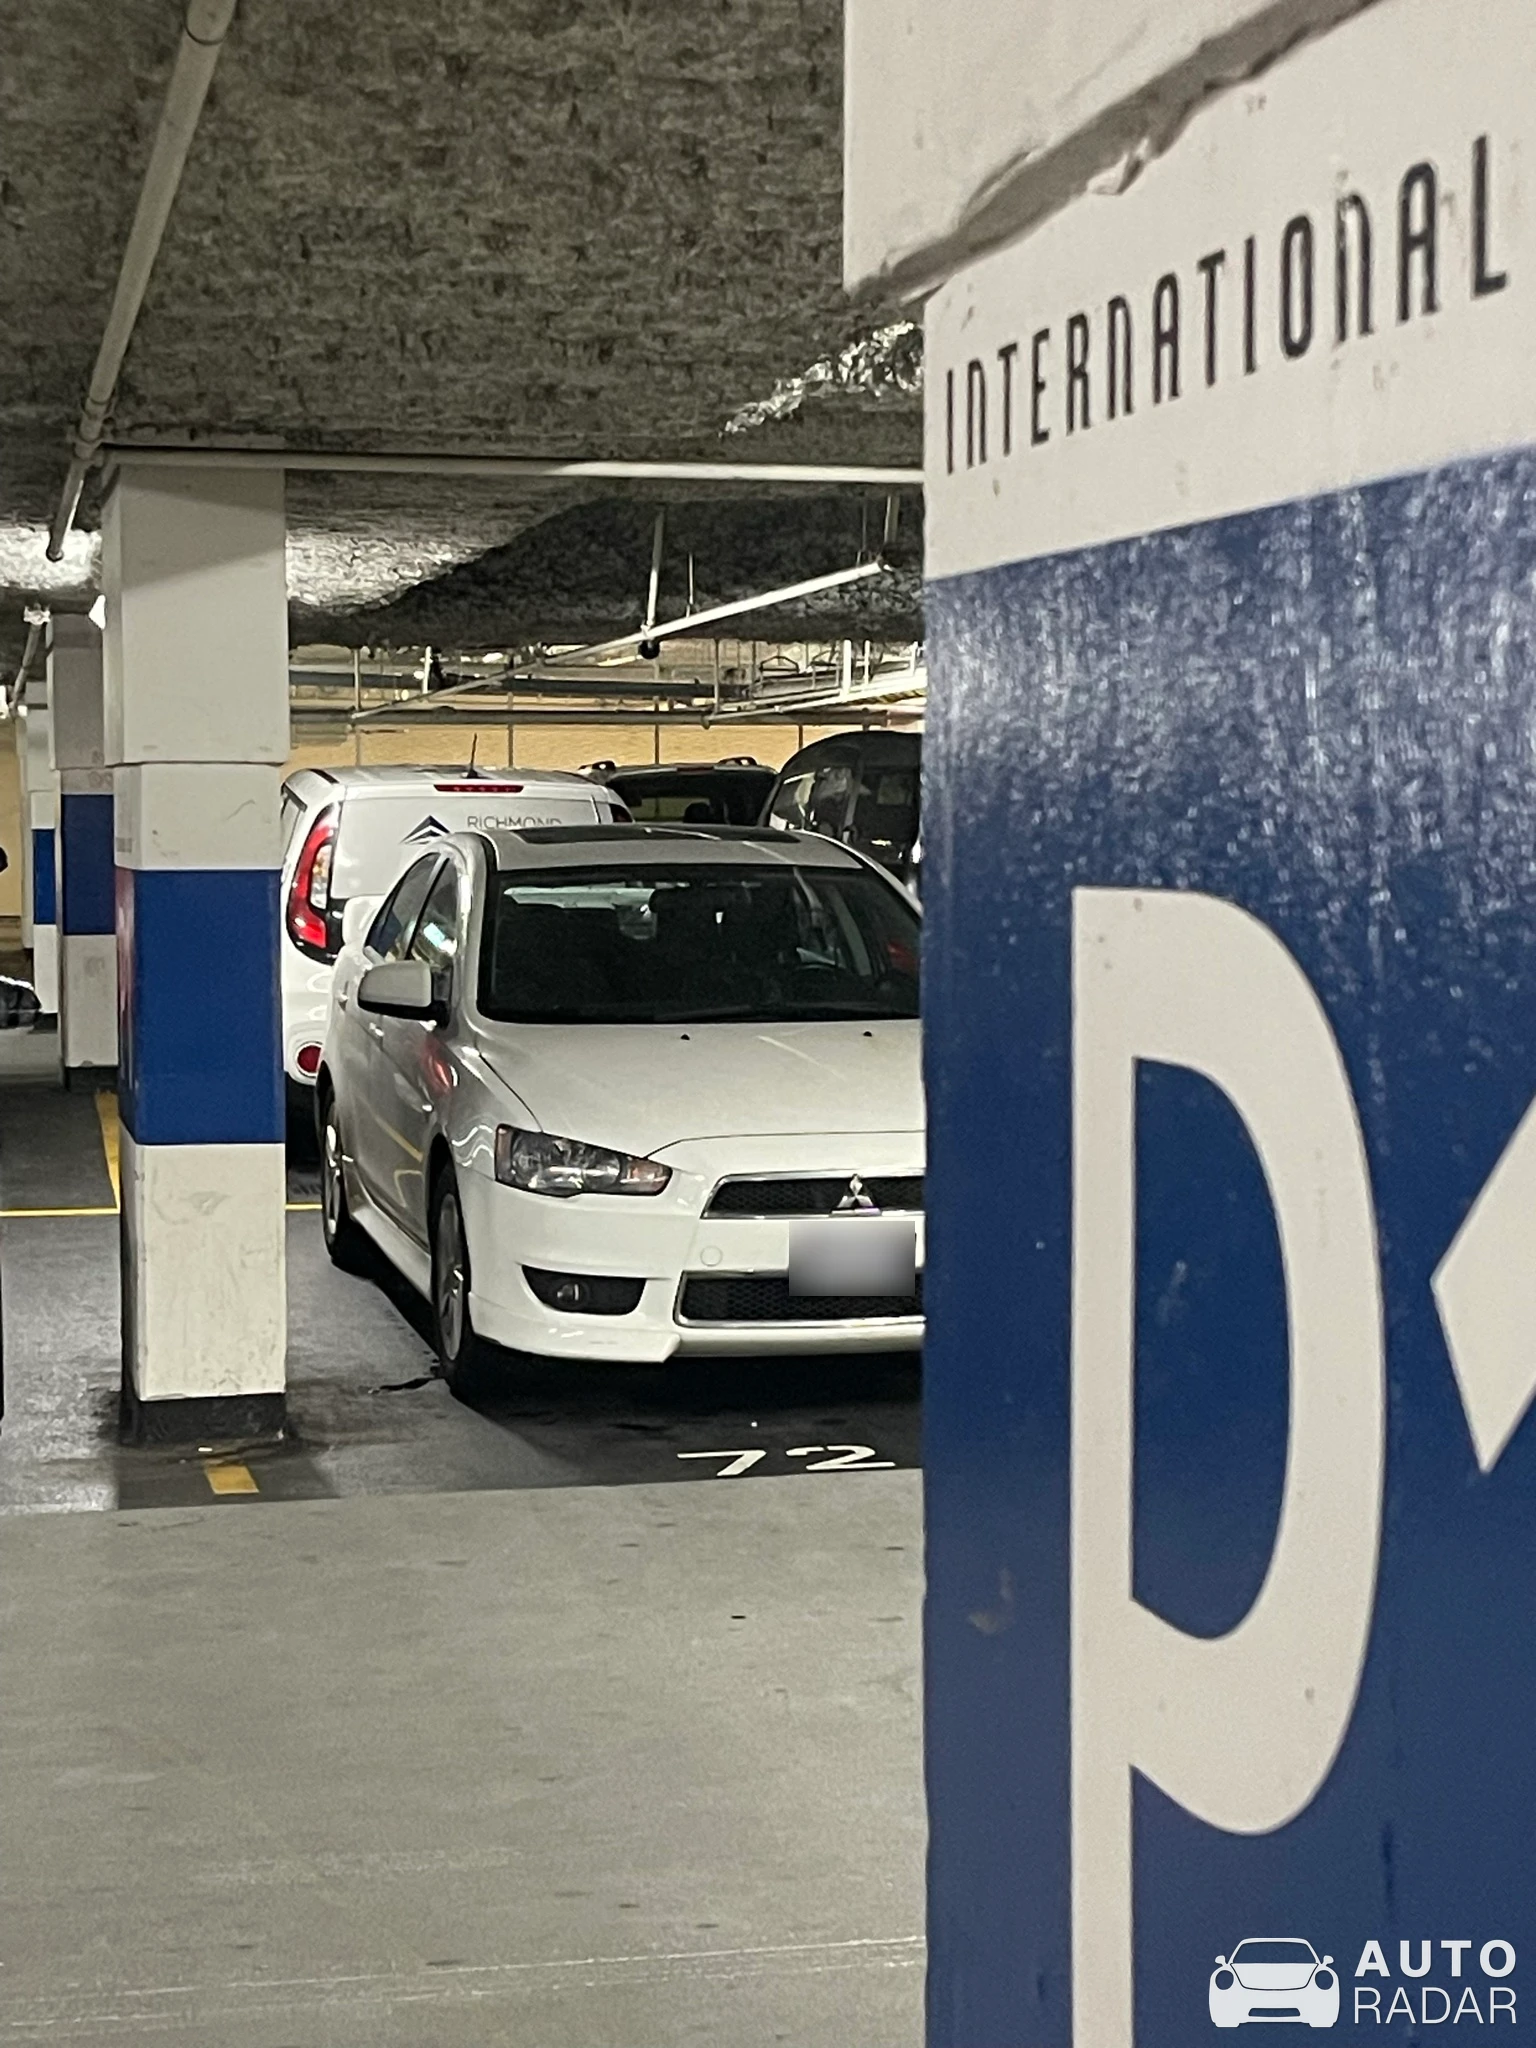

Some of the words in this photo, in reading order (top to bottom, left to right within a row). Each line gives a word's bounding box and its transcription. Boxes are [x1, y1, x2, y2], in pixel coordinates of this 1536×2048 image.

[946, 134, 1509, 474] INTERNATIONAL
[677, 1445, 895, 1476] 72
[1071, 887, 1536, 2048] P
